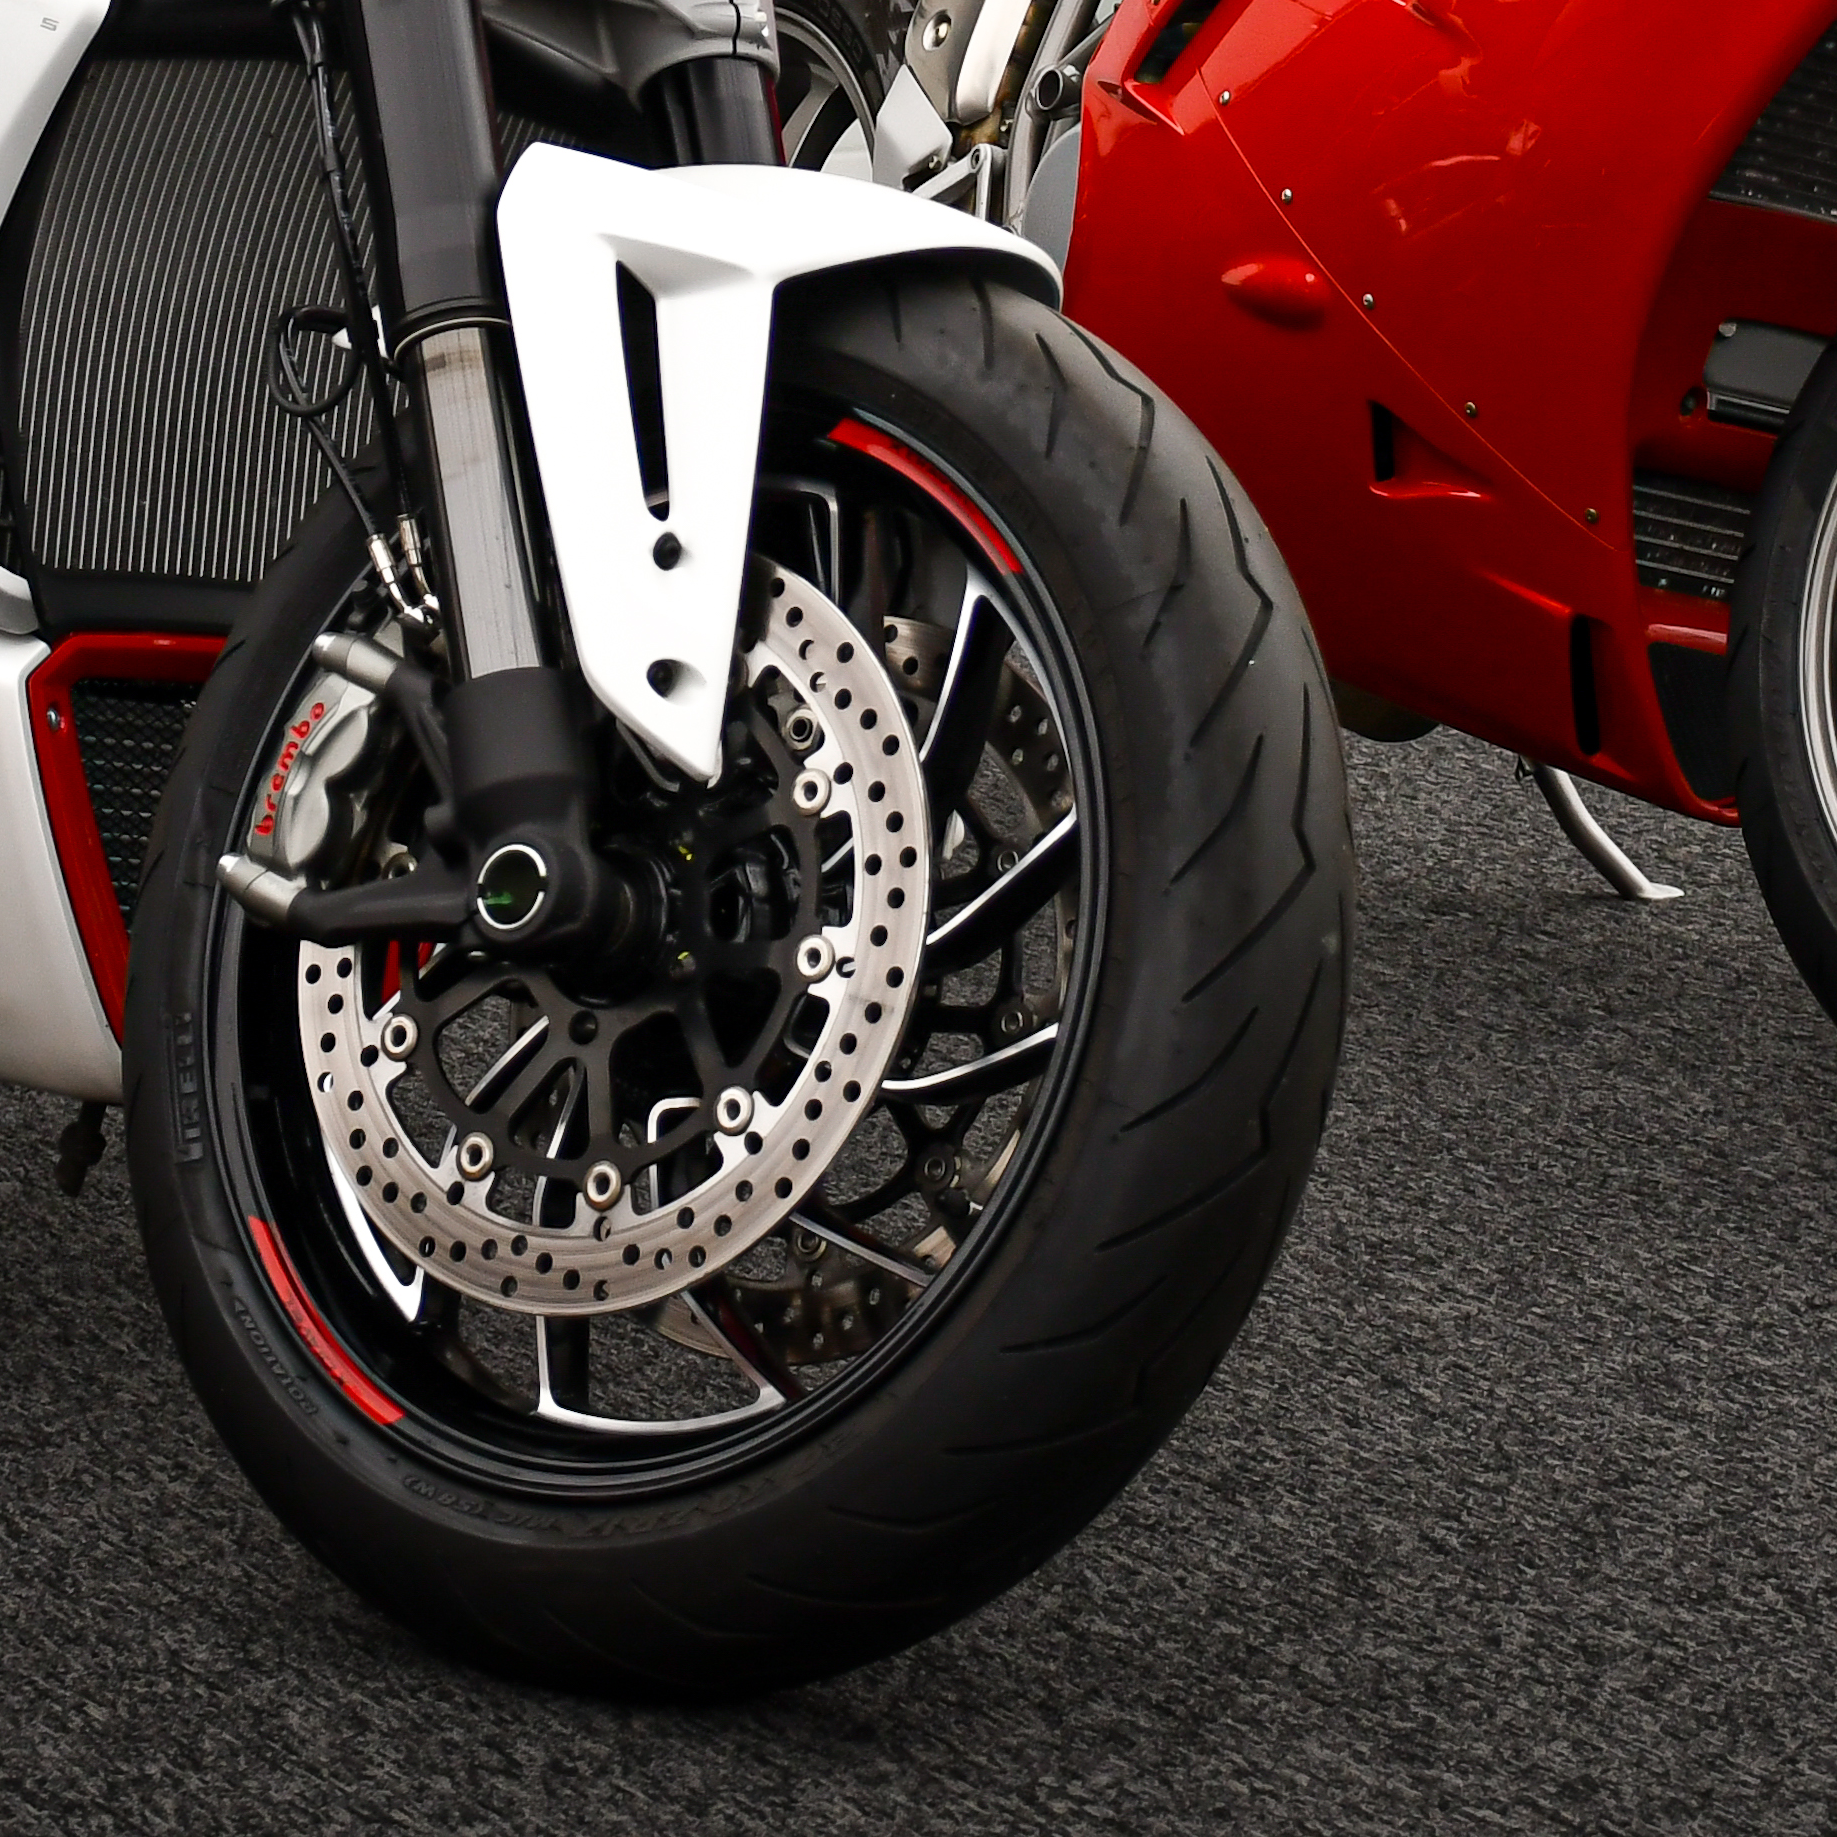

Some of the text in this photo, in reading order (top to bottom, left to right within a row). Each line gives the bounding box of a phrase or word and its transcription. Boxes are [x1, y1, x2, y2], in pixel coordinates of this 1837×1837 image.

[254, 700, 325, 837] brembo
[166, 1011, 205, 1163] PIRELLI
[237, 1310, 320, 1418] ROTATION
